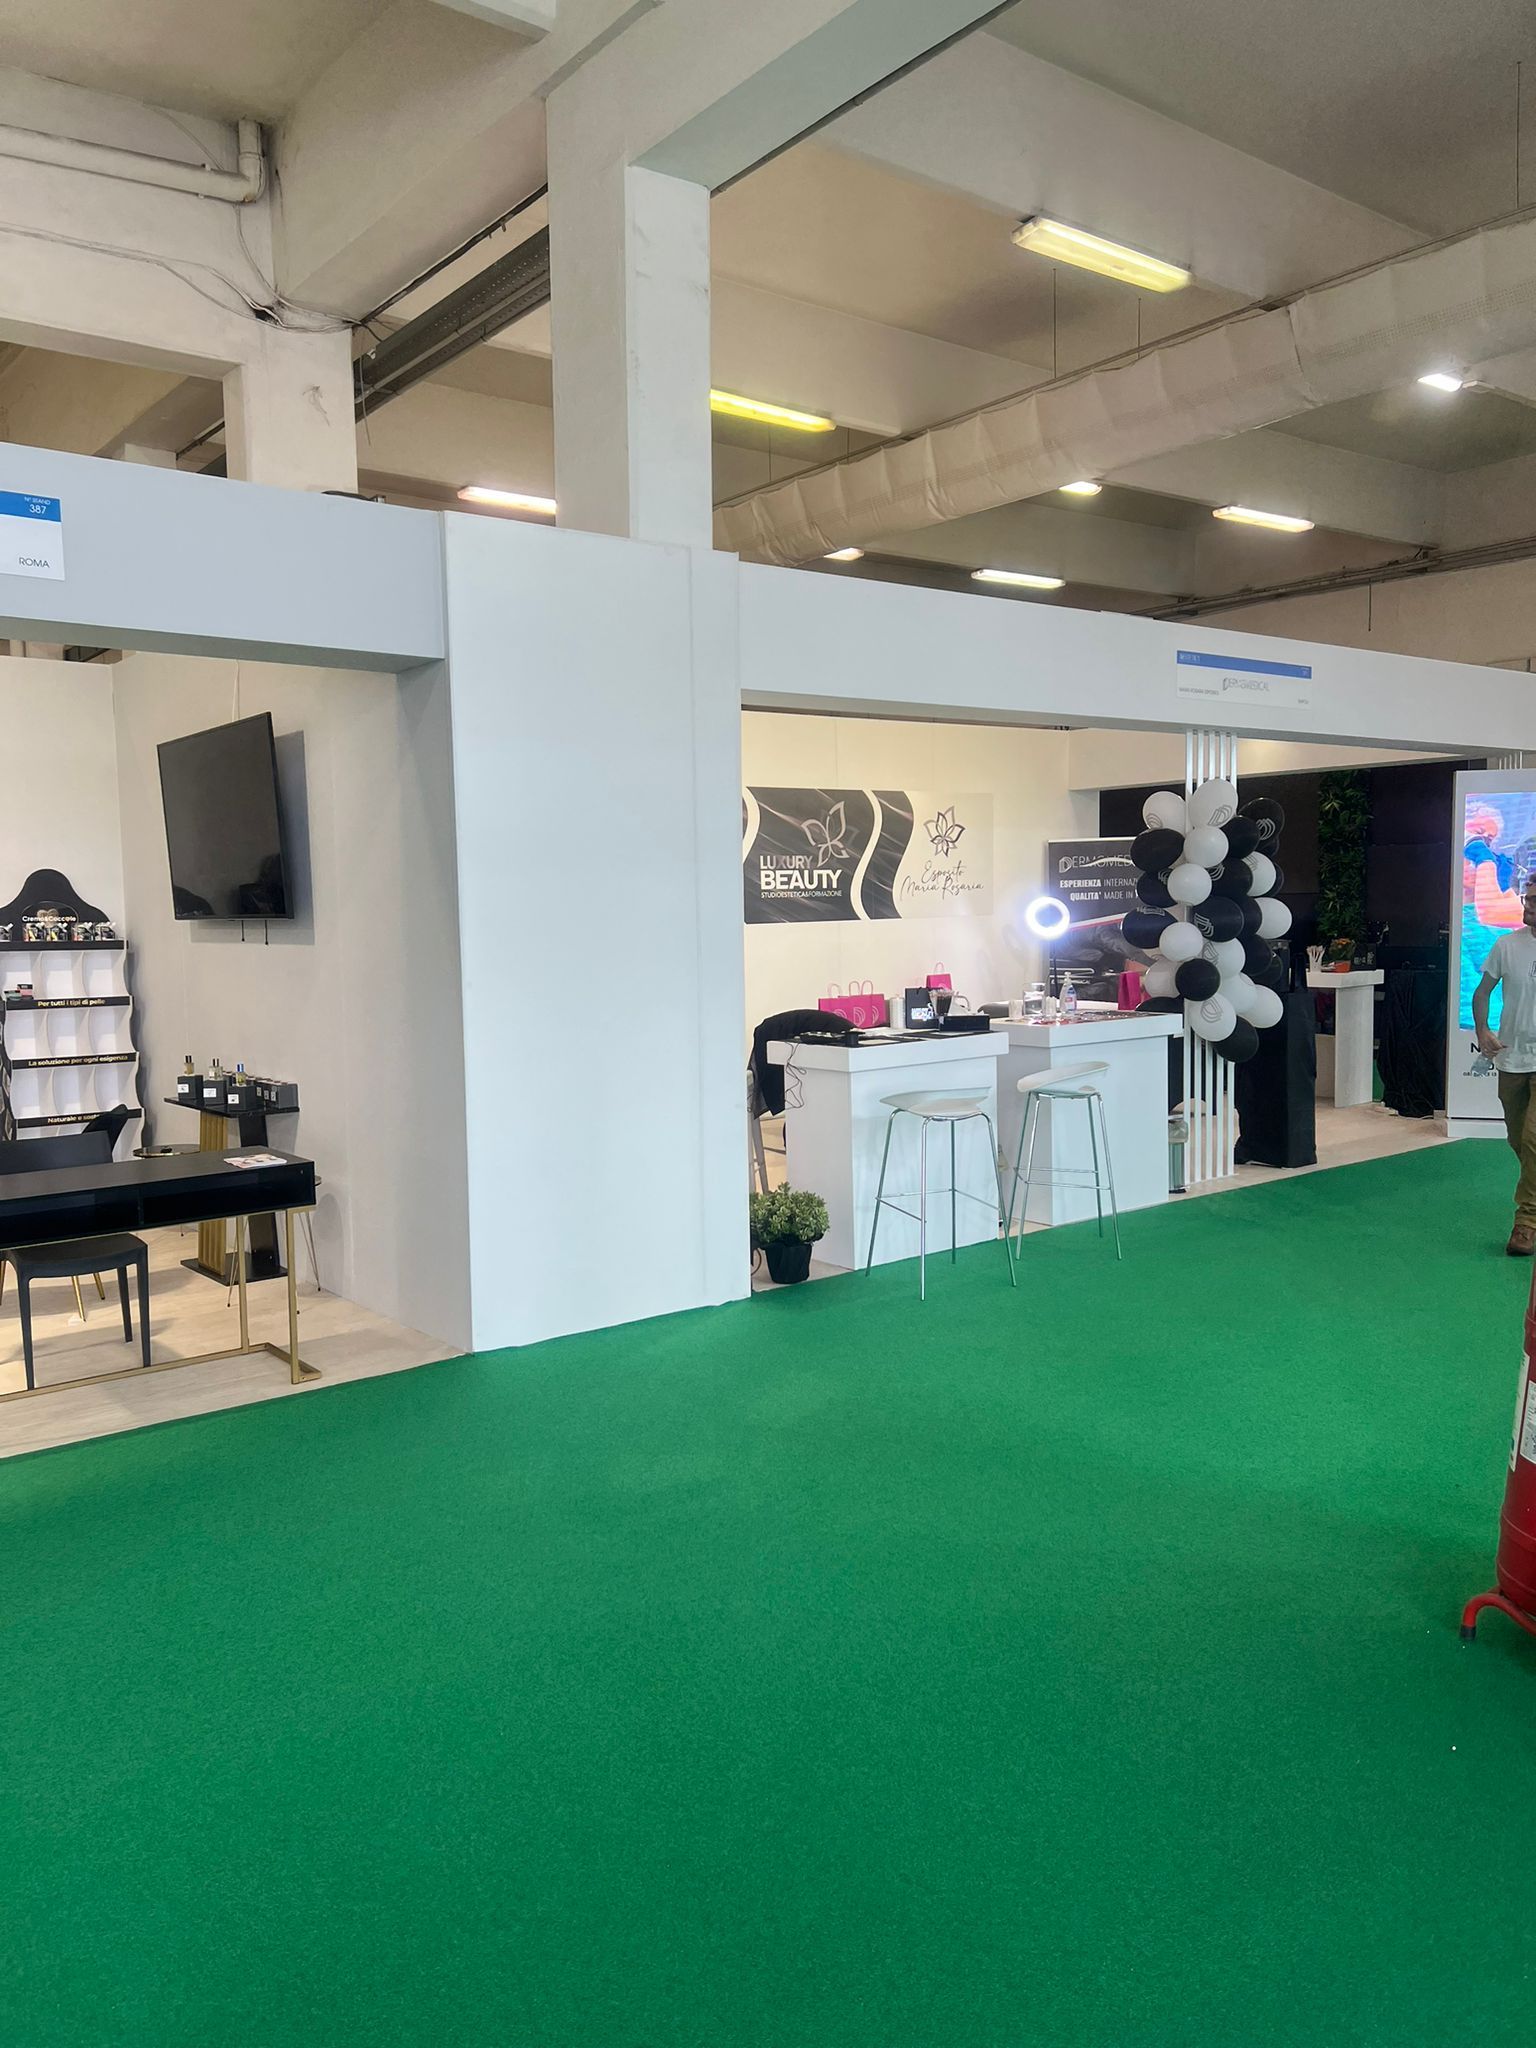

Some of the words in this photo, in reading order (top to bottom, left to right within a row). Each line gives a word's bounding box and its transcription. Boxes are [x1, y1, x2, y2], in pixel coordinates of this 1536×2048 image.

[29, 504, 47, 514] 387
[19, 557, 50, 569] ROMA
[759, 855, 814, 870] LUXURY
[1059, 855, 1132, 873] DERMOMED
[921, 859, 965, 884] Esposito
[760, 869, 842, 890] BEAUTY
[1060, 879, 1101, 888] ESPERIENZA
[1103, 878, 1137, 887] INTERNAZ
[900, 875, 941, 902] Maria
[941, 874, 985, 901] Rosaria
[1070, 891, 1102, 901] QUALITA'
[1104, 890, 1123, 899] MADE
[1126, 890, 1134, 899] IN
[71, 1058, 82, 1066] per
[83, 1057, 98, 1065] ogni
[99, 1055, 128, 1063] esigenza
[47, 1116, 77, 1124] Naturale
